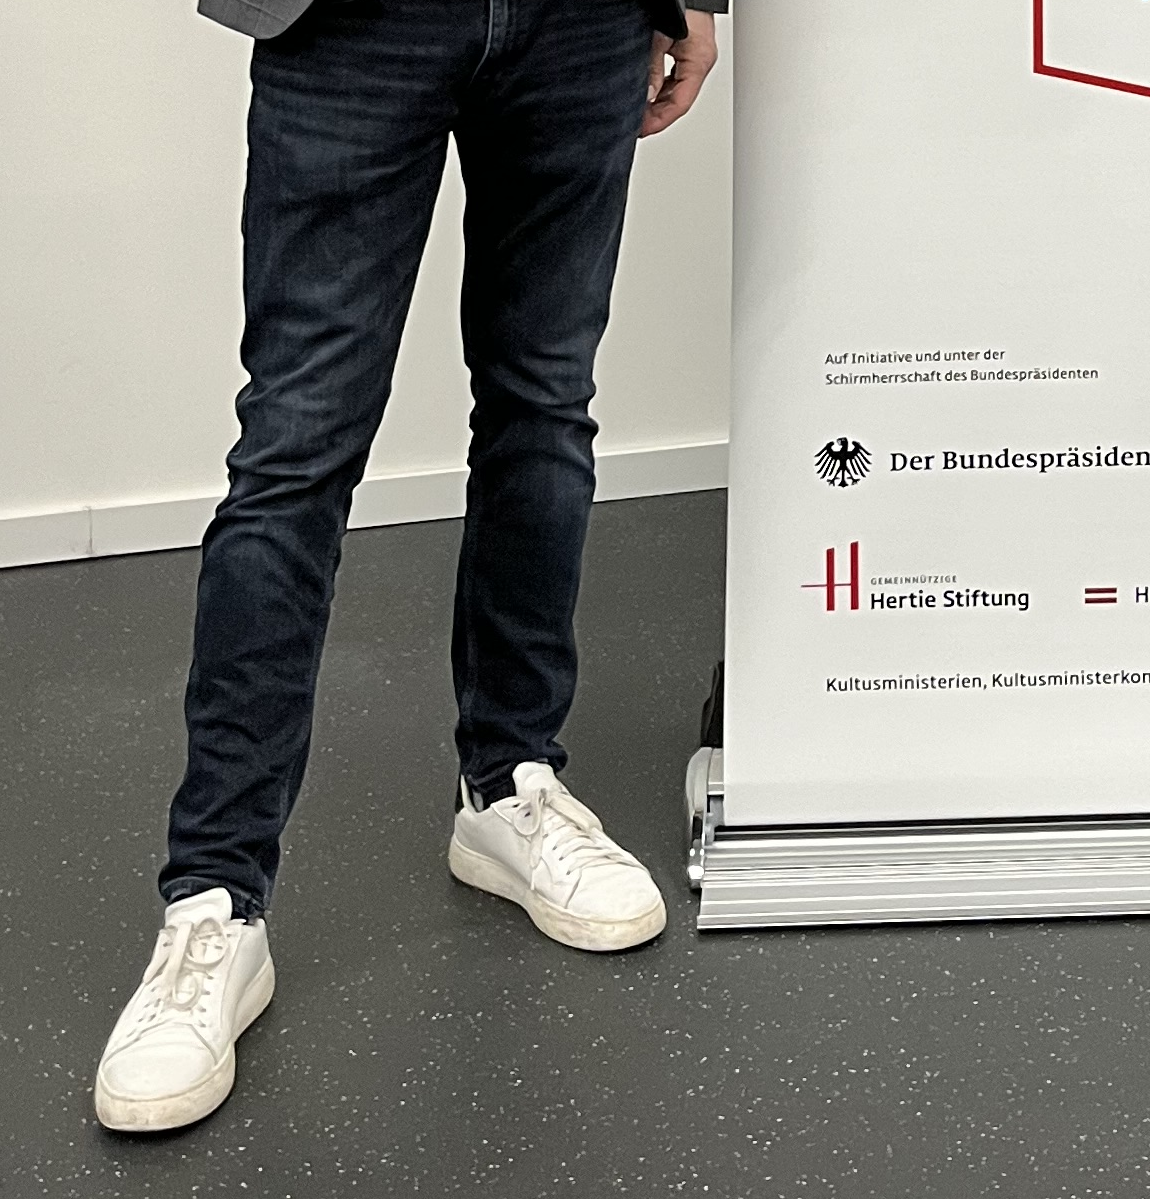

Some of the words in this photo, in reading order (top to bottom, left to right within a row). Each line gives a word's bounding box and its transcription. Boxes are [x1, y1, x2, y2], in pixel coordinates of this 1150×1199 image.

[825, 353, 848, 364] Auf
[852, 352, 912, 364] Initiative
[916, 351, 940, 362] und
[944, 351, 980, 361] unter
[984, 349, 1005, 360] der
[826, 371, 941, 385] Schirmherrschaft
[945, 370, 967, 381] des
[971, 368, 1098, 381] Bundespräsidenten
[890, 453, 935, 471] Der
[871, 575, 956, 585] GEMEINNÜTZIGE
[871, 590, 936, 609] Hertie
[944, 589, 1028, 611] Stiftung
[827, 674, 987, 691] Kultusministerien,
